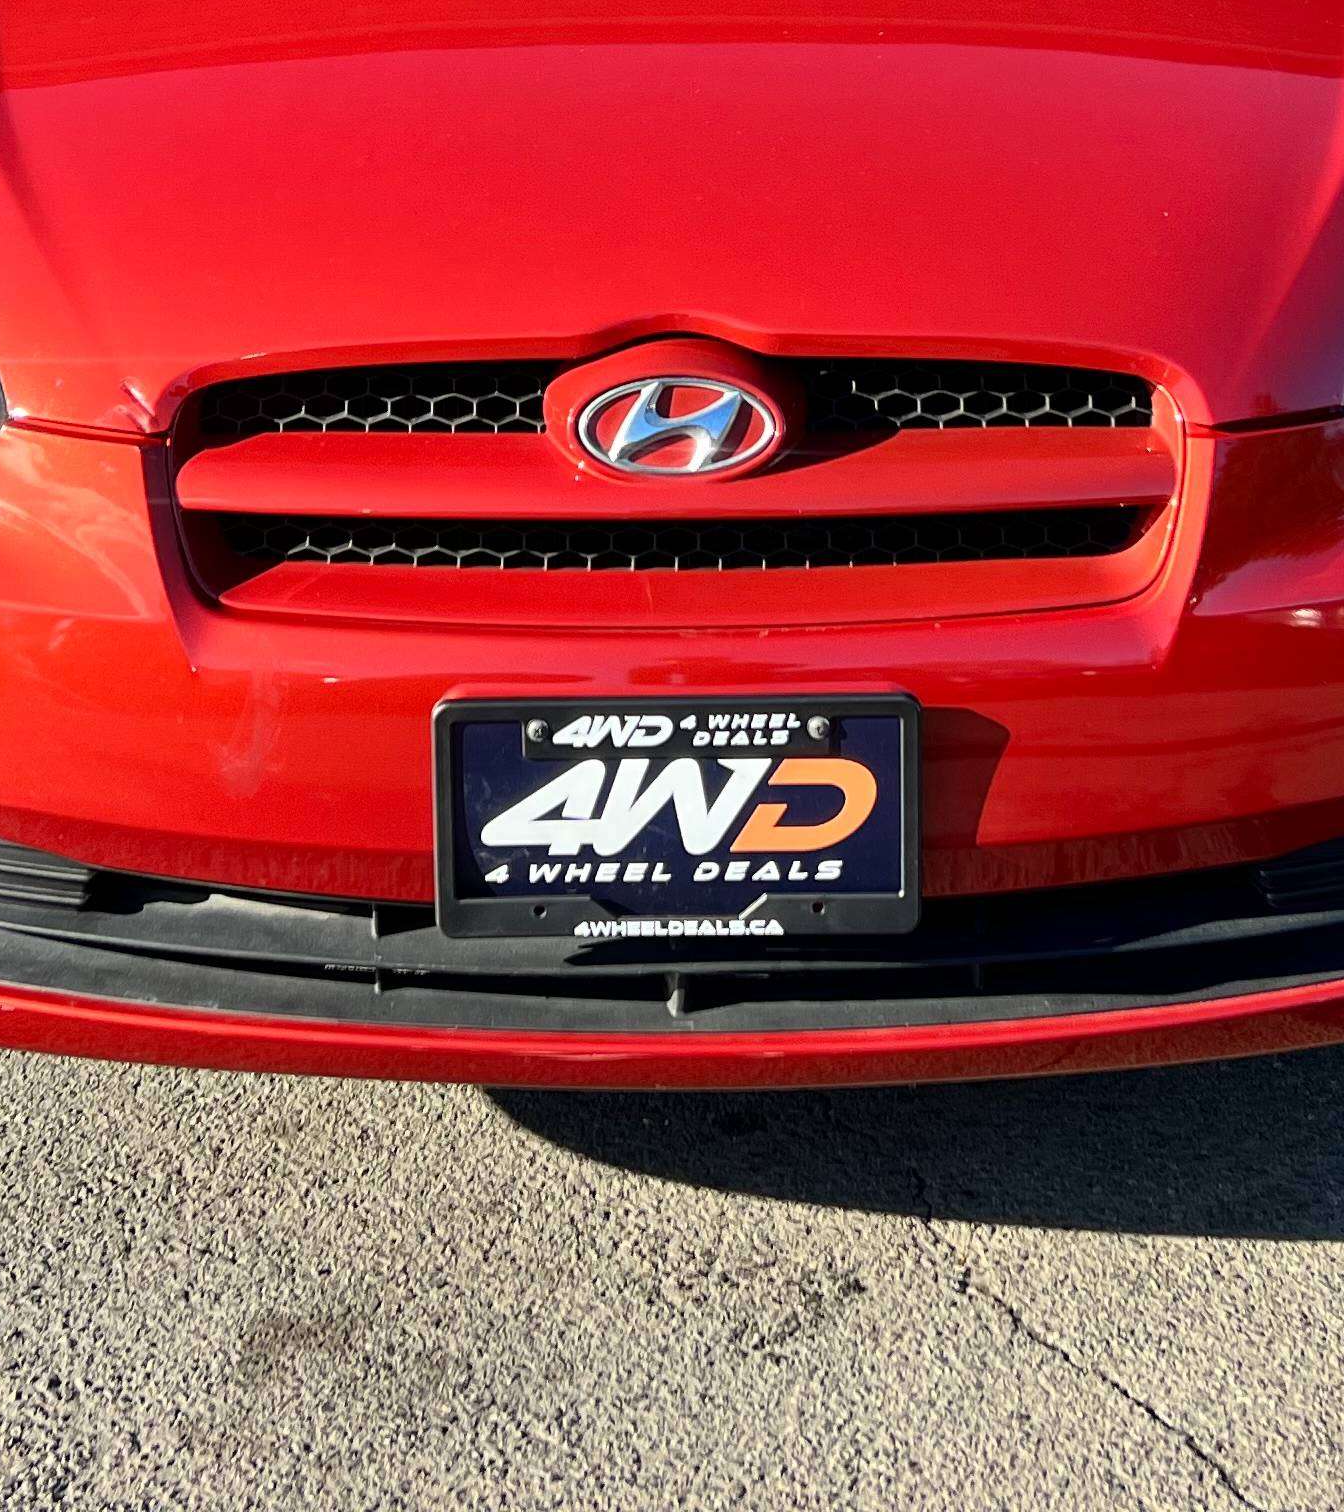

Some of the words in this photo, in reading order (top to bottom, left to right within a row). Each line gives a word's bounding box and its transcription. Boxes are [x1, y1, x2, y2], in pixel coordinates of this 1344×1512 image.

[552, 714, 674, 748] 4WD
[679, 714, 697, 730] 4
[708, 713, 801, 730] WHEEL
[692, 730, 789, 747] DEALS
[480, 758, 878, 856] 4WD
[484, 864, 509, 884] 4
[529, 862, 673, 884] WHEEL
[693, 860, 844, 883] DEALS
[573, 919, 784, 936] 4WHEELDEALS.CA
